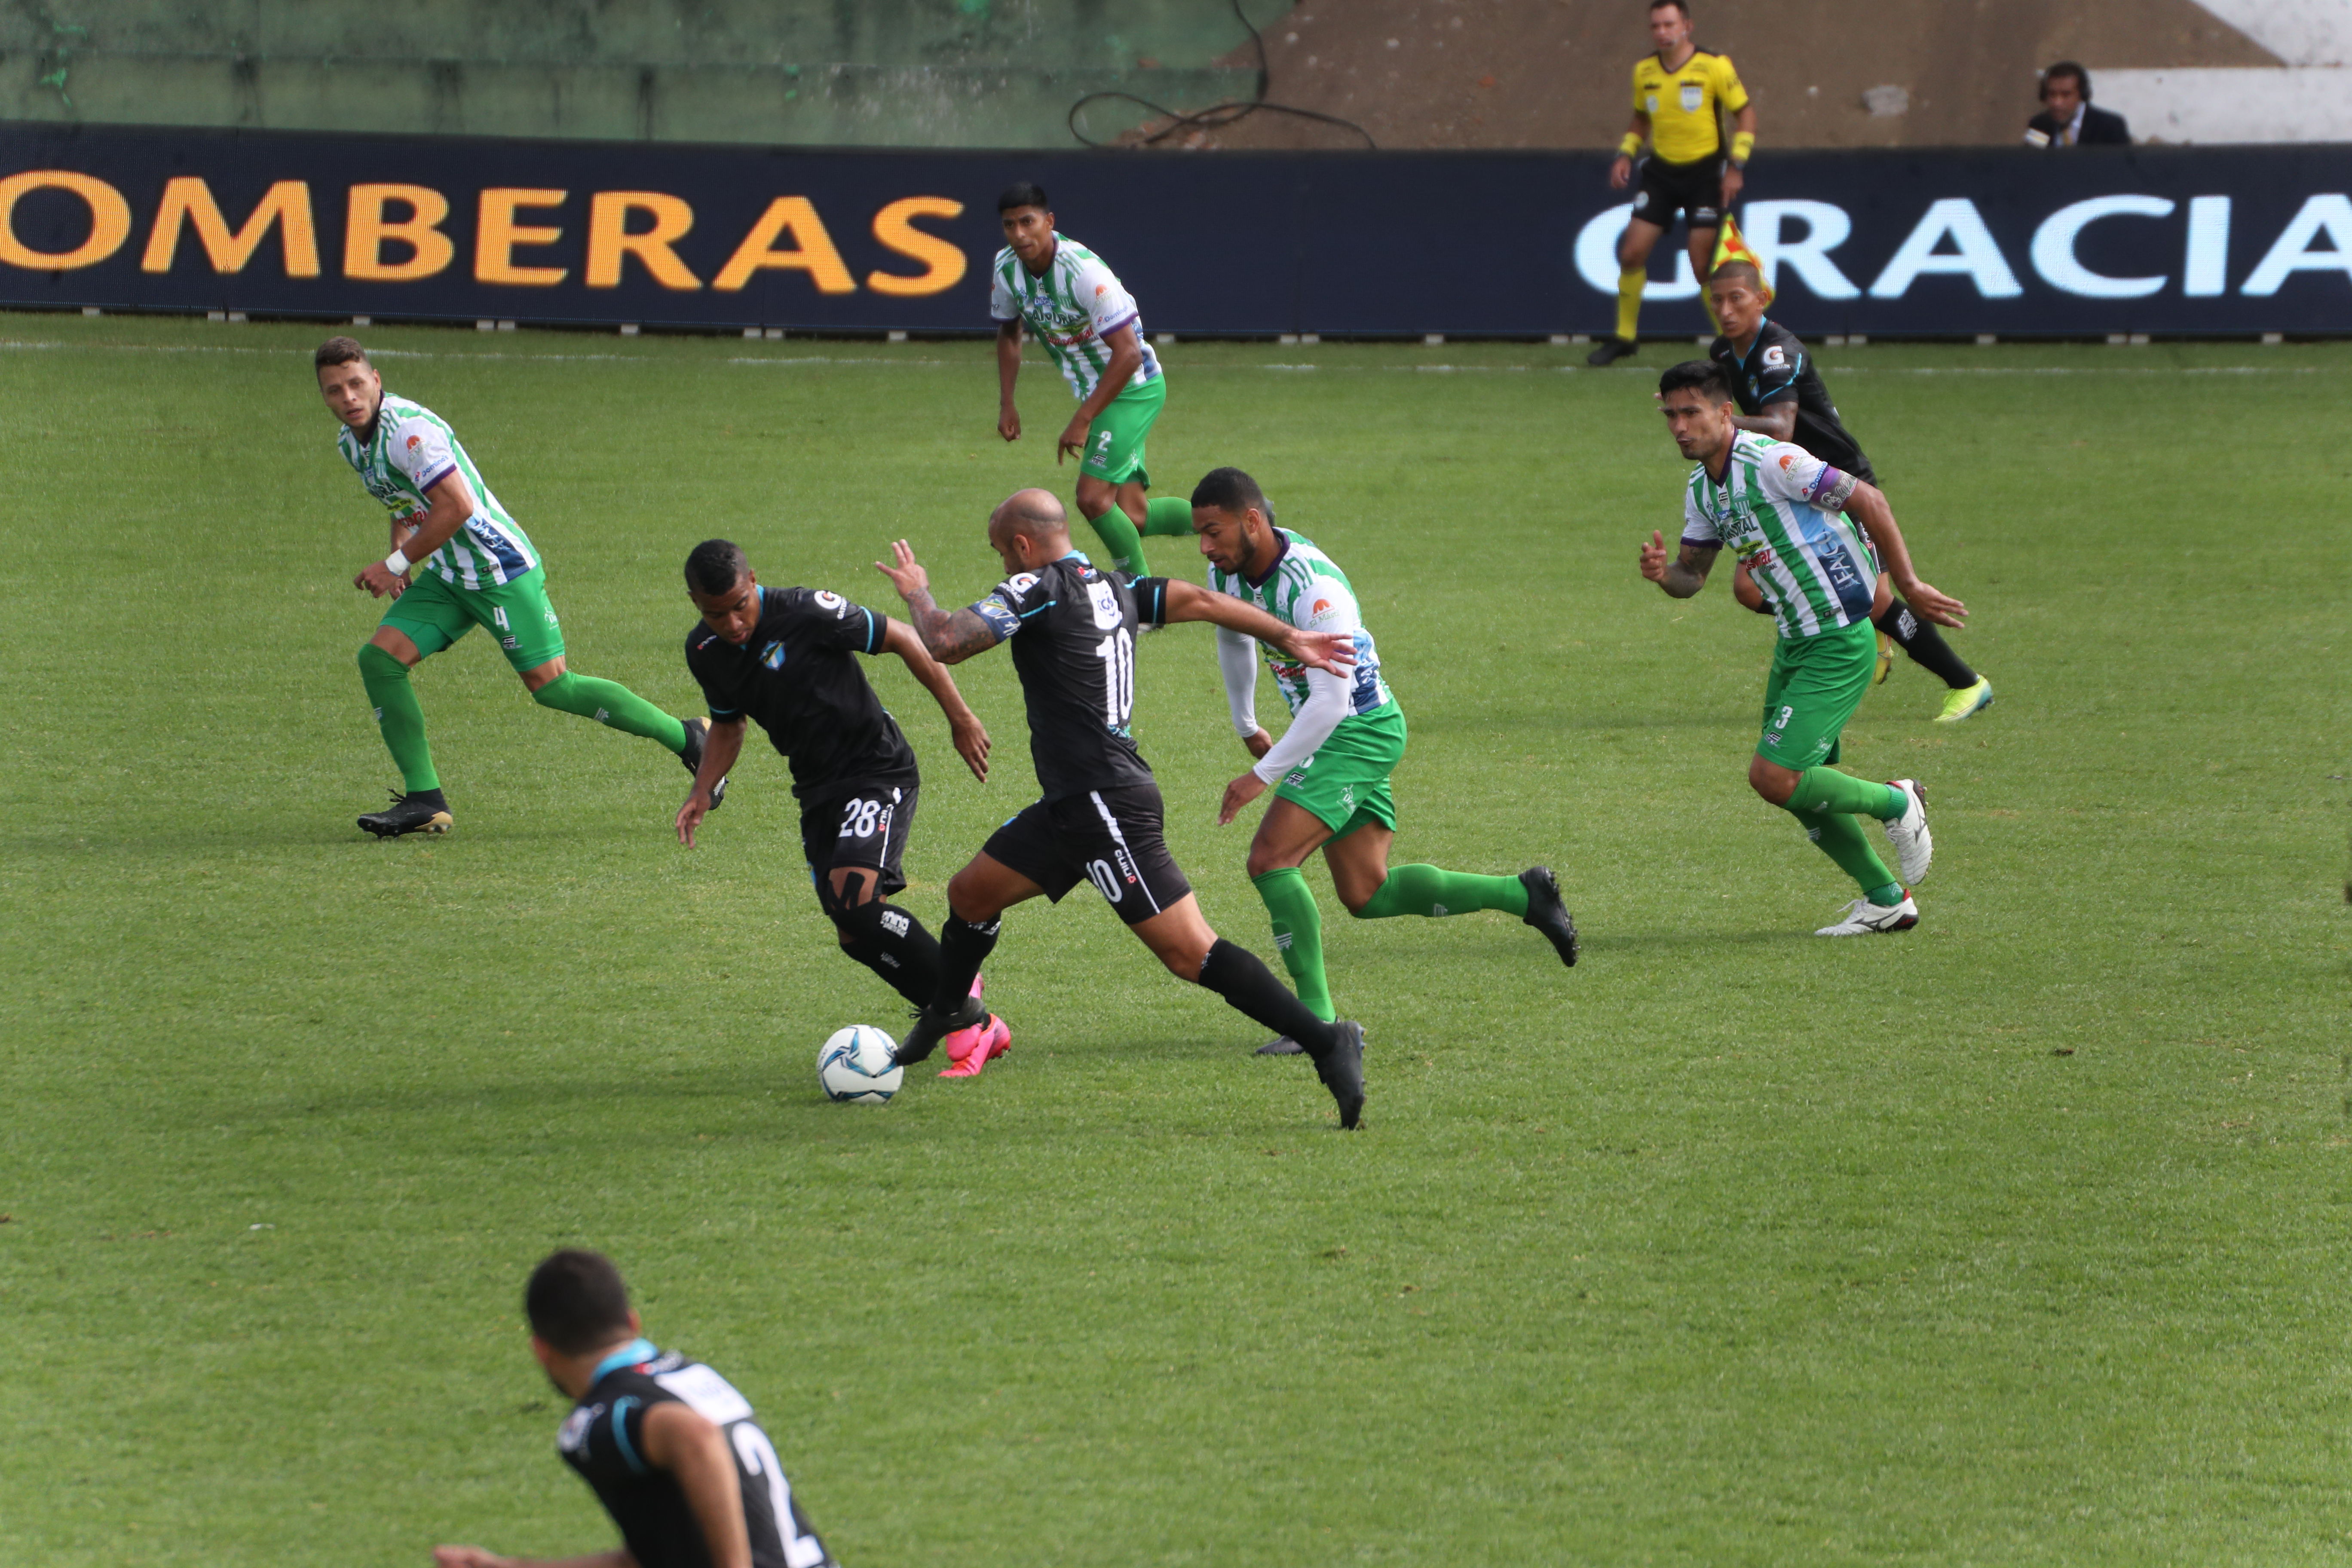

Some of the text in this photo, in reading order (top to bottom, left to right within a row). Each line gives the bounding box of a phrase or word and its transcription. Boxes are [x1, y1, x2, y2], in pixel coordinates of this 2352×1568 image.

[0, 169, 967, 297] OMBERAS
[1763, 364, 1791, 374] GATORADE
[1098, 431, 1112, 452] 2
[493, 606, 510, 631] 4
[1096, 626, 1133, 725] 10
[1775, 705, 1793, 729] 3
[838, 797, 881, 838] 28
